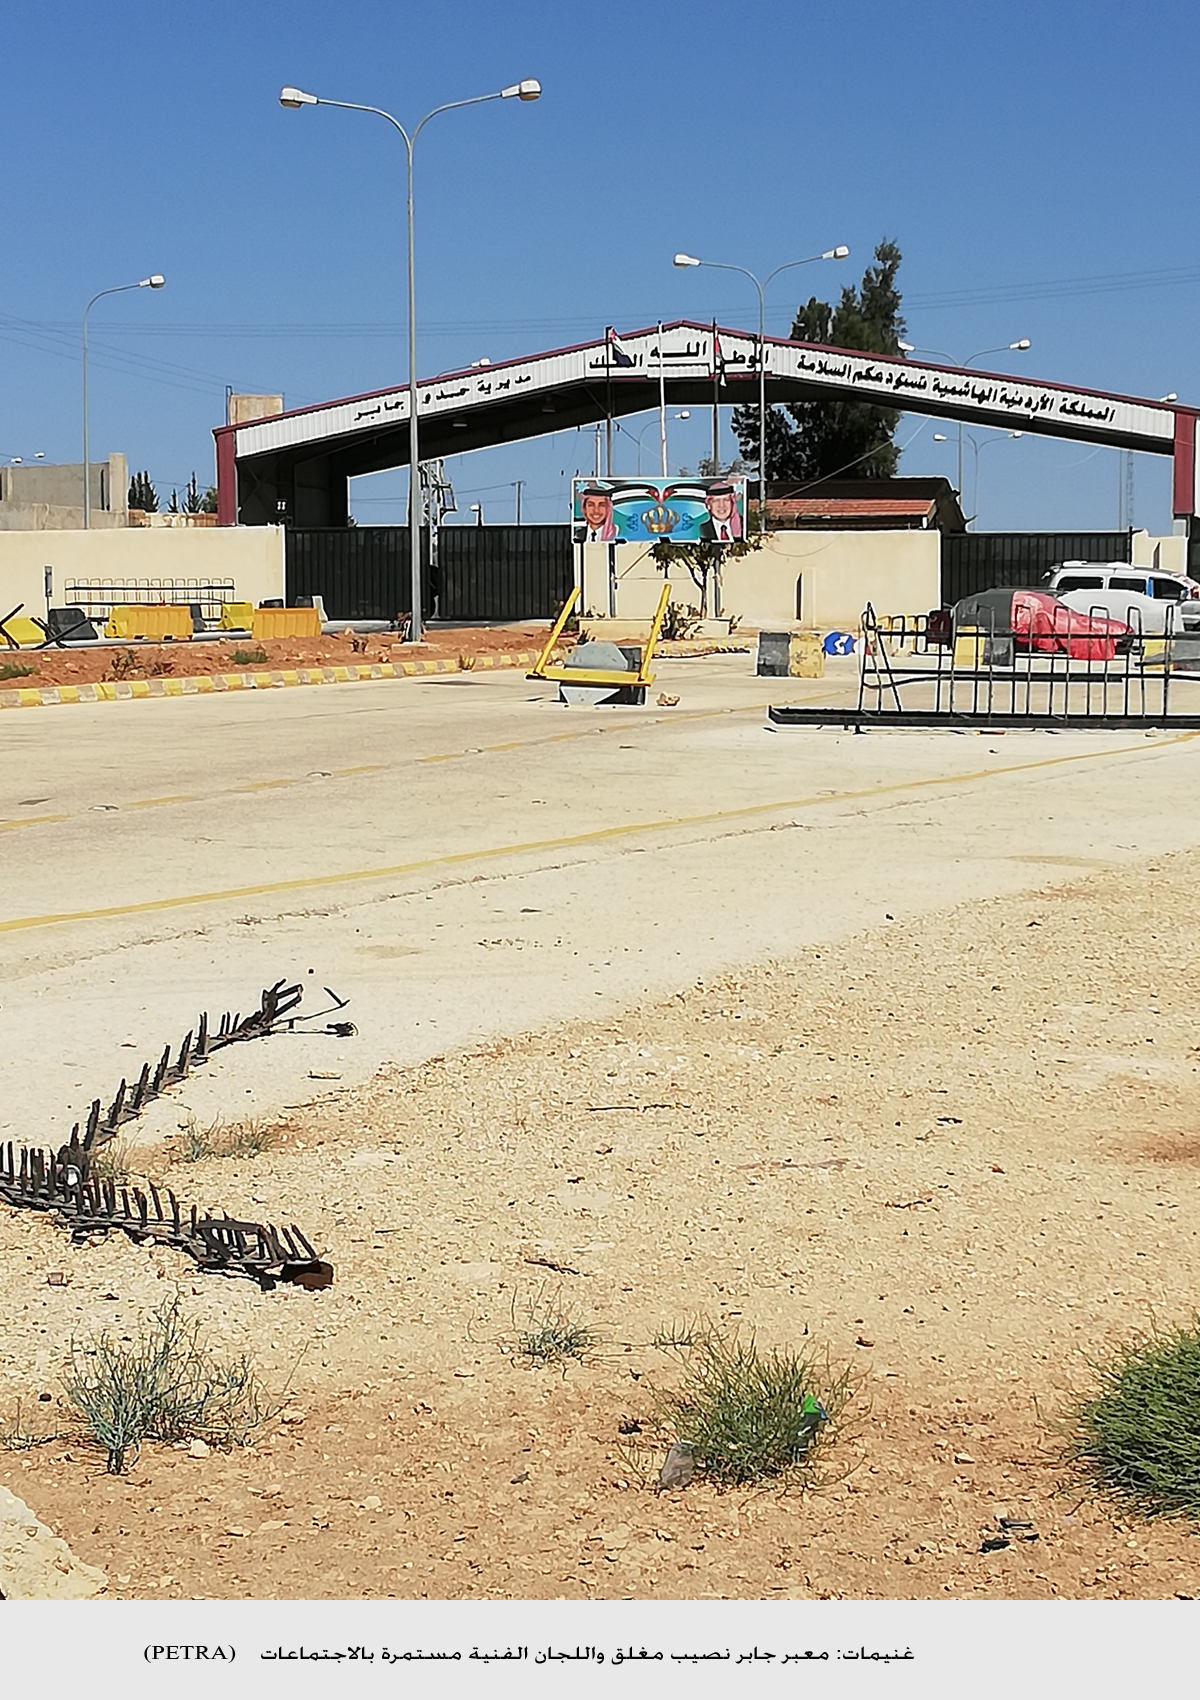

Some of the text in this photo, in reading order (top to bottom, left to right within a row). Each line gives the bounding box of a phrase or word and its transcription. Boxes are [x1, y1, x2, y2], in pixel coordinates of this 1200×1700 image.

[650, 340, 707, 358] الله
[797, 354, 852, 380] السلامة
[354, 374, 532, 421] مديرية حدو جابر
[932, 376, 997, 406] الهاشمية
[999, 387, 1055, 412] الأردنية
[1059, 397, 1116, 423] المملكة
